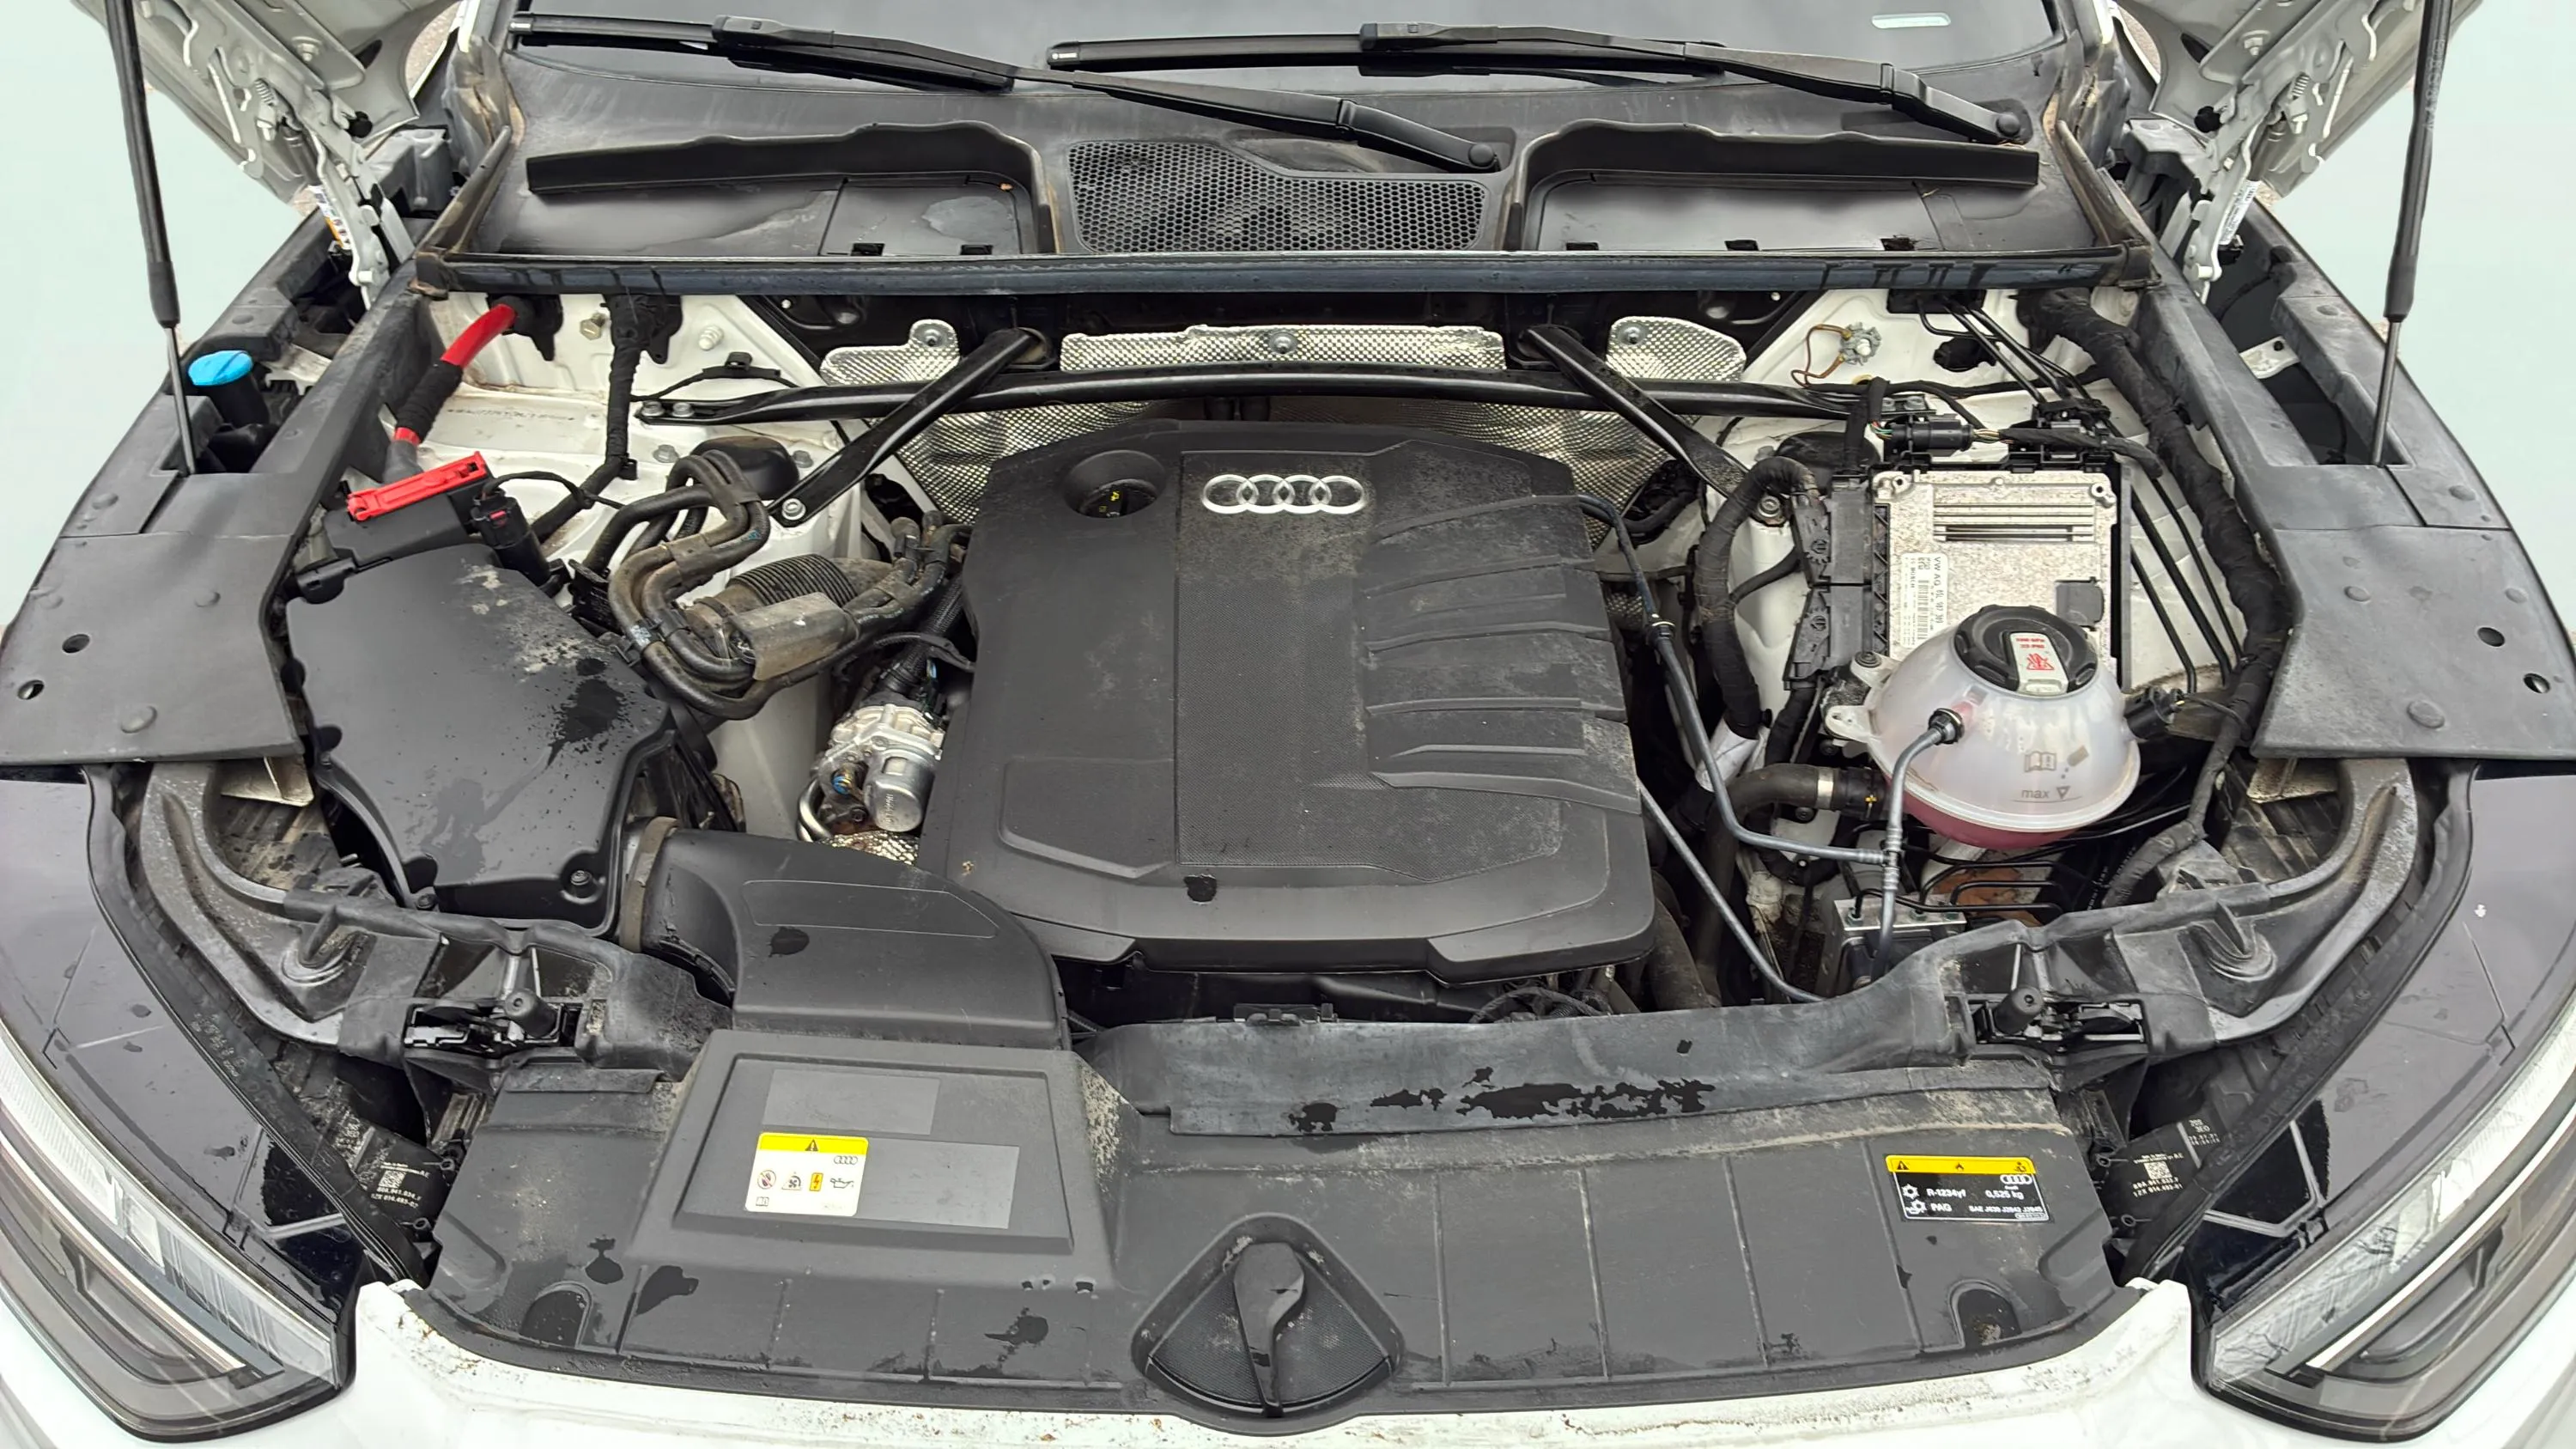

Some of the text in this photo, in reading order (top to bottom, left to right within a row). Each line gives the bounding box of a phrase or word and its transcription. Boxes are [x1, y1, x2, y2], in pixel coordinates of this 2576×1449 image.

[1934, 557, 1941, 571] VW
[2021, 789, 2050, 799] max
[1926, 1188, 2024, 1200] R-1234yf 0,525 kg
[1930, 1202, 1953, 1212] PAG
